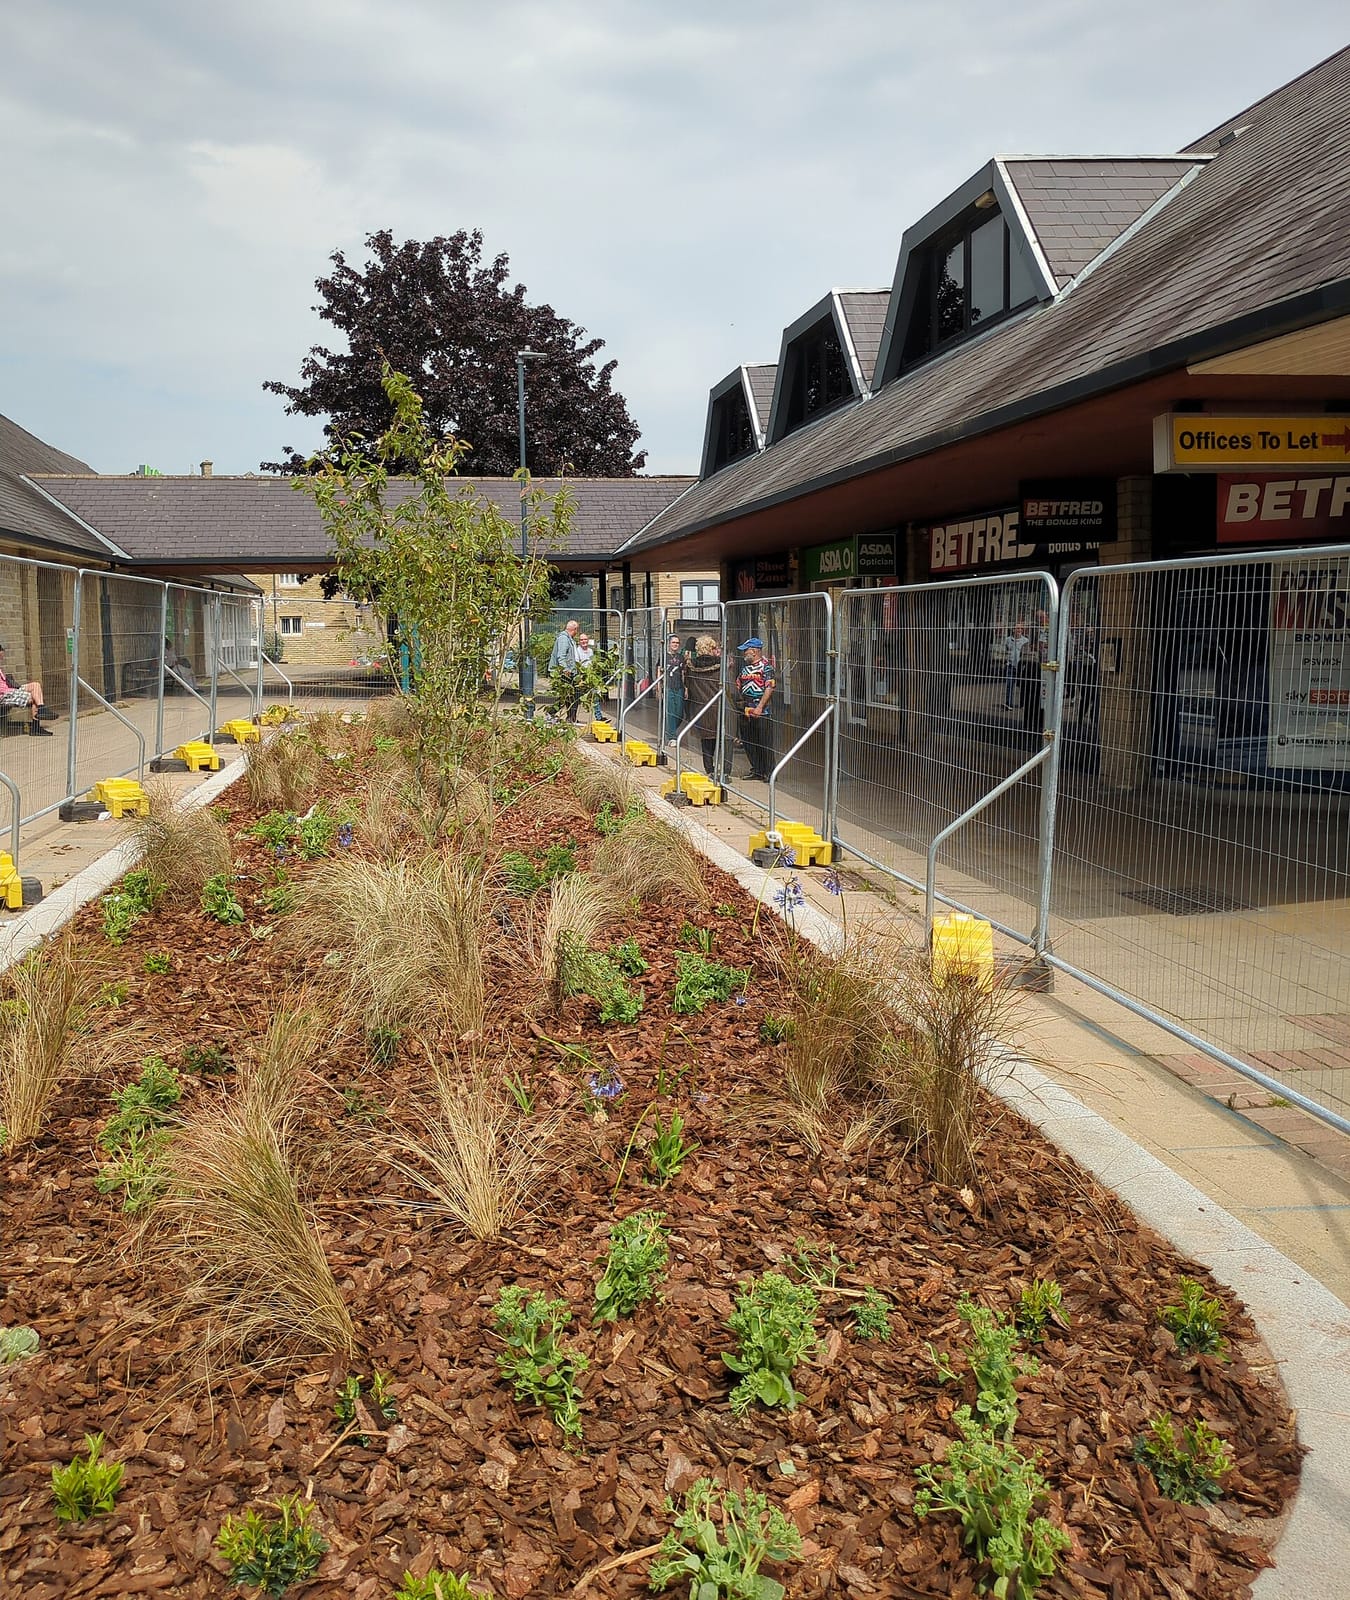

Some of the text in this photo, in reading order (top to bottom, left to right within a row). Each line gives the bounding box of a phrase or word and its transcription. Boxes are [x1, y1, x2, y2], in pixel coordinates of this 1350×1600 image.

[1179, 431, 1319, 449] Offices To Let
[1026, 500, 1104, 516] BETFRED
[1026, 517, 1103, 527] THE BONUS KING
[859, 543, 893, 555] ASDA
[756, 560, 786, 572] Shoe
[819, 549, 841, 573] ASDA
[859, 558, 894, 568] Optician
[756, 573, 787, 583] Zone
[1274, 590, 1350, 629] MIS
[1286, 690, 1307, 703] sky
